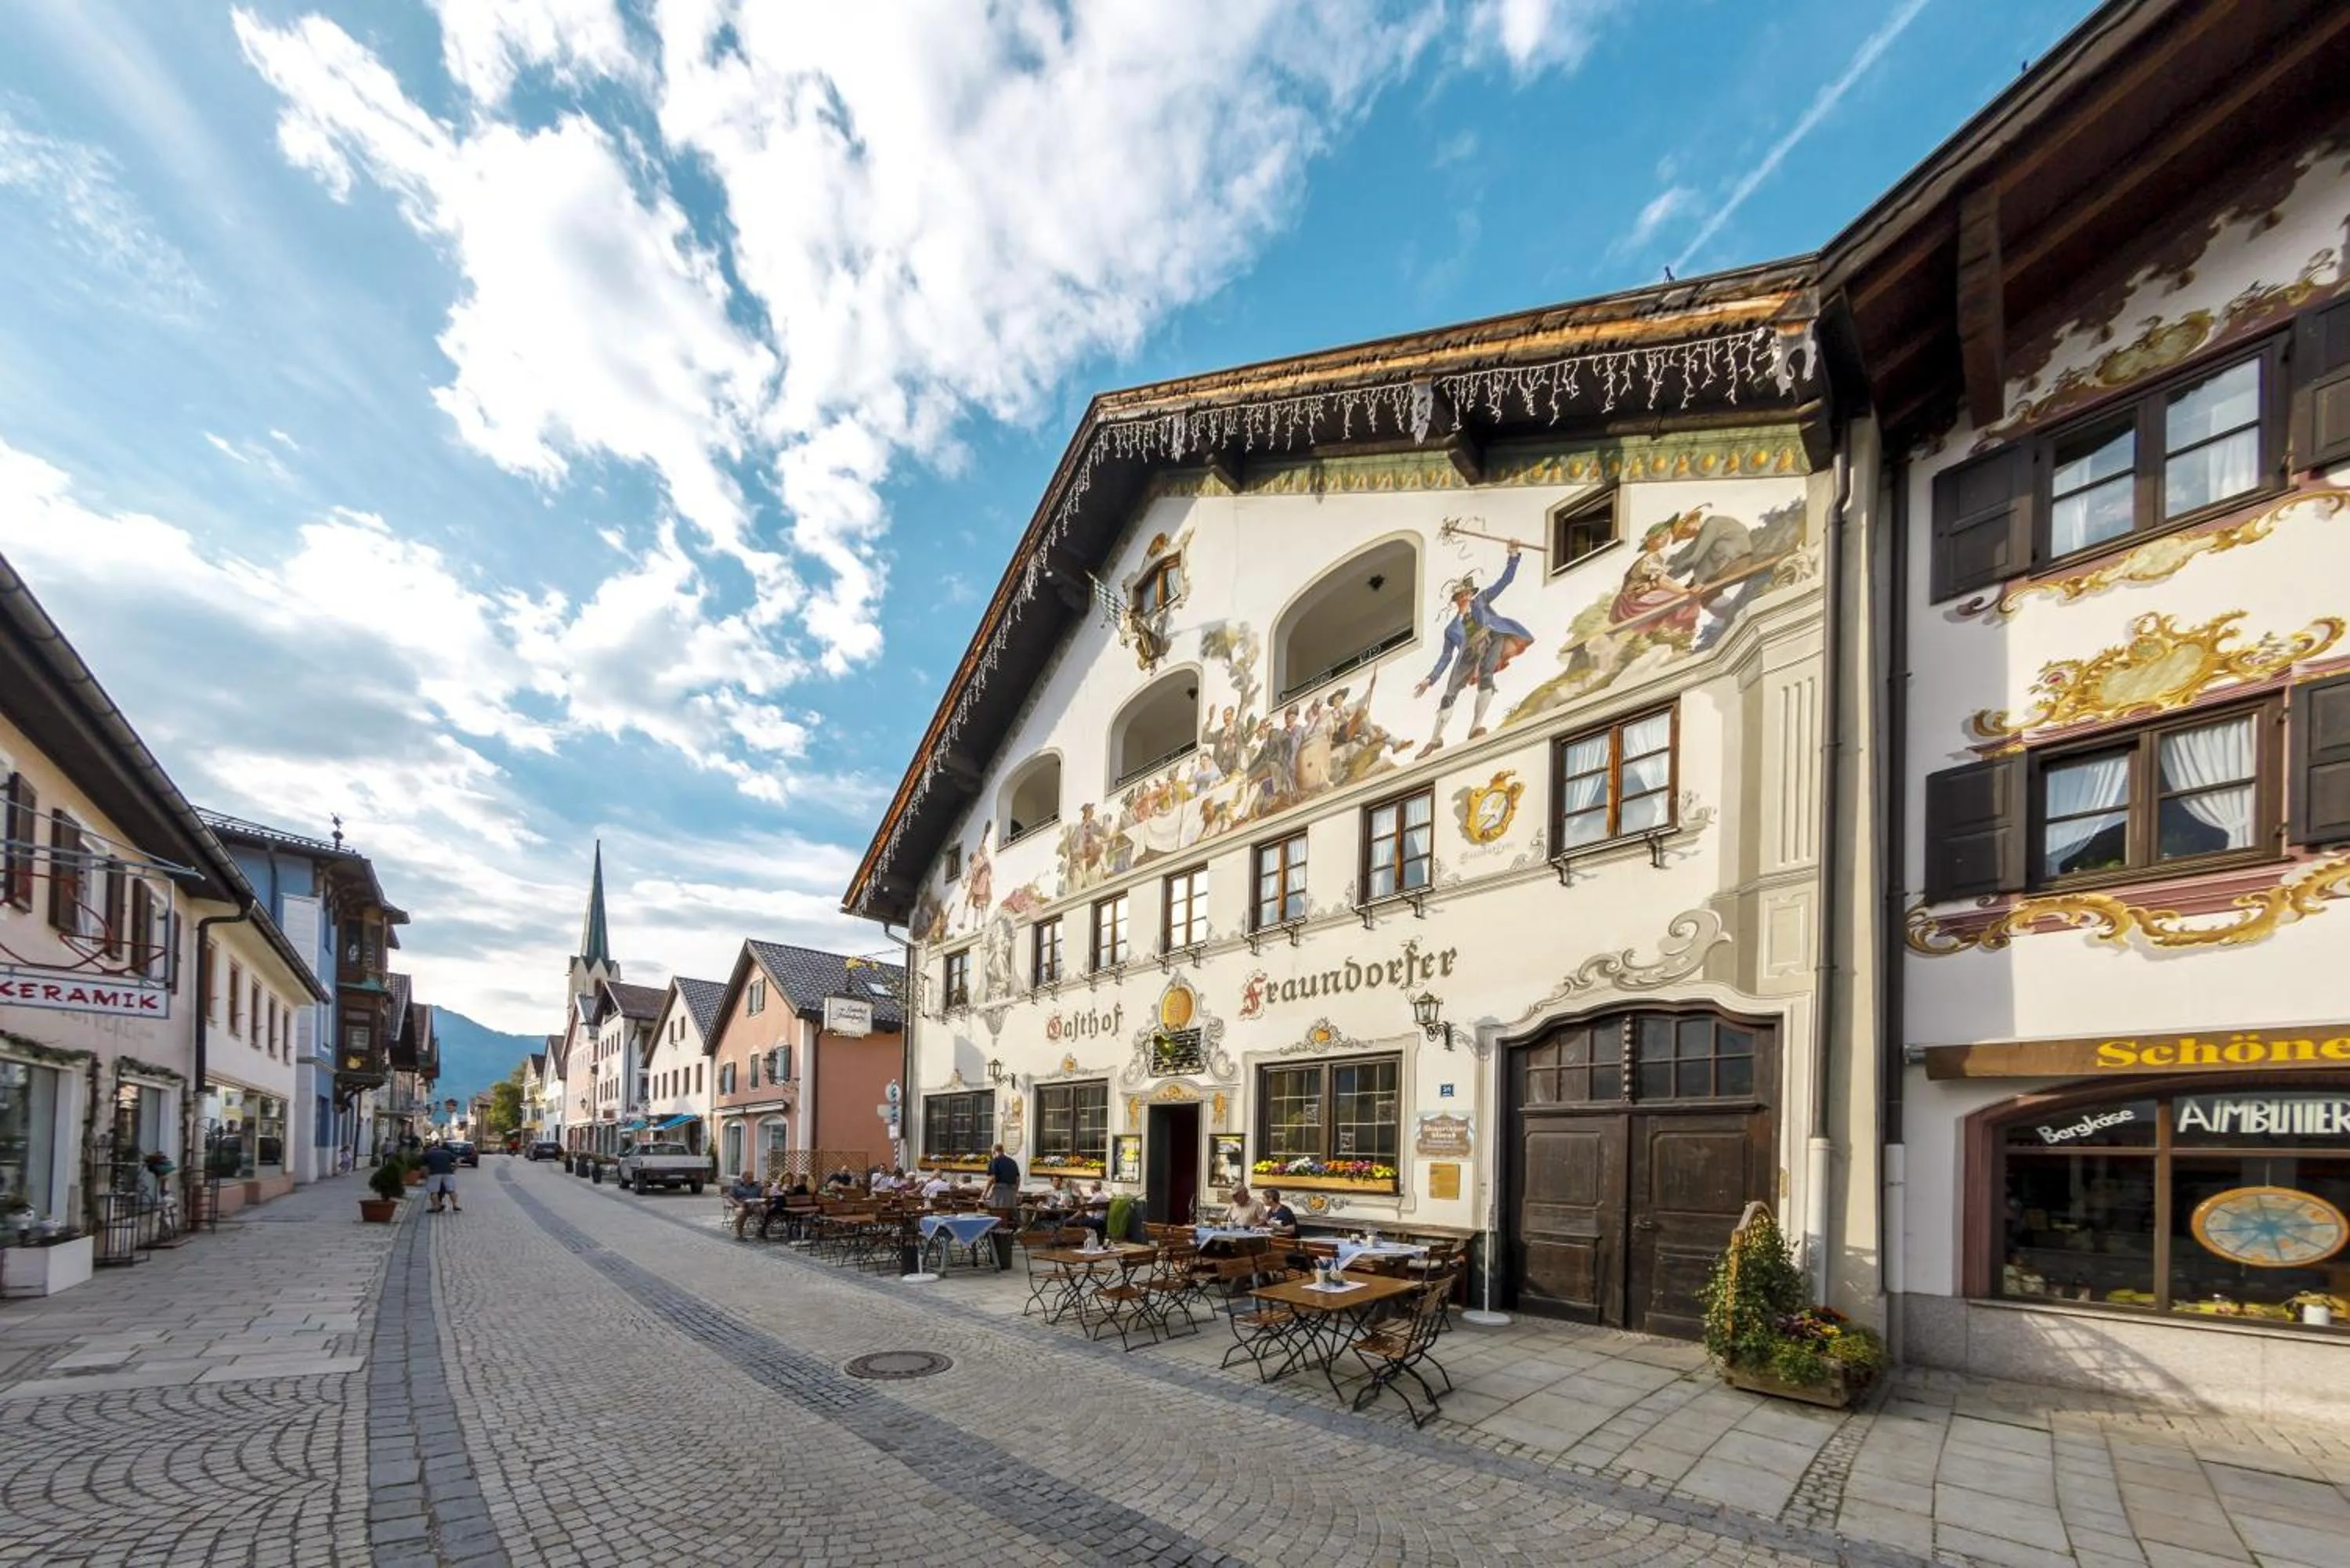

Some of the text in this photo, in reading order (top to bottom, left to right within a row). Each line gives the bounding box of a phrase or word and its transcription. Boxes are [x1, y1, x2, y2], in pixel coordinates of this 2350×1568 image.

[0, 981, 159, 1009] KERAMIK
[1240, 938, 1458, 1021] Fraundorfer
[2096, 1034, 2350, 1068] Schöne
[2037, 1110, 2135, 1143] Bergkäse
